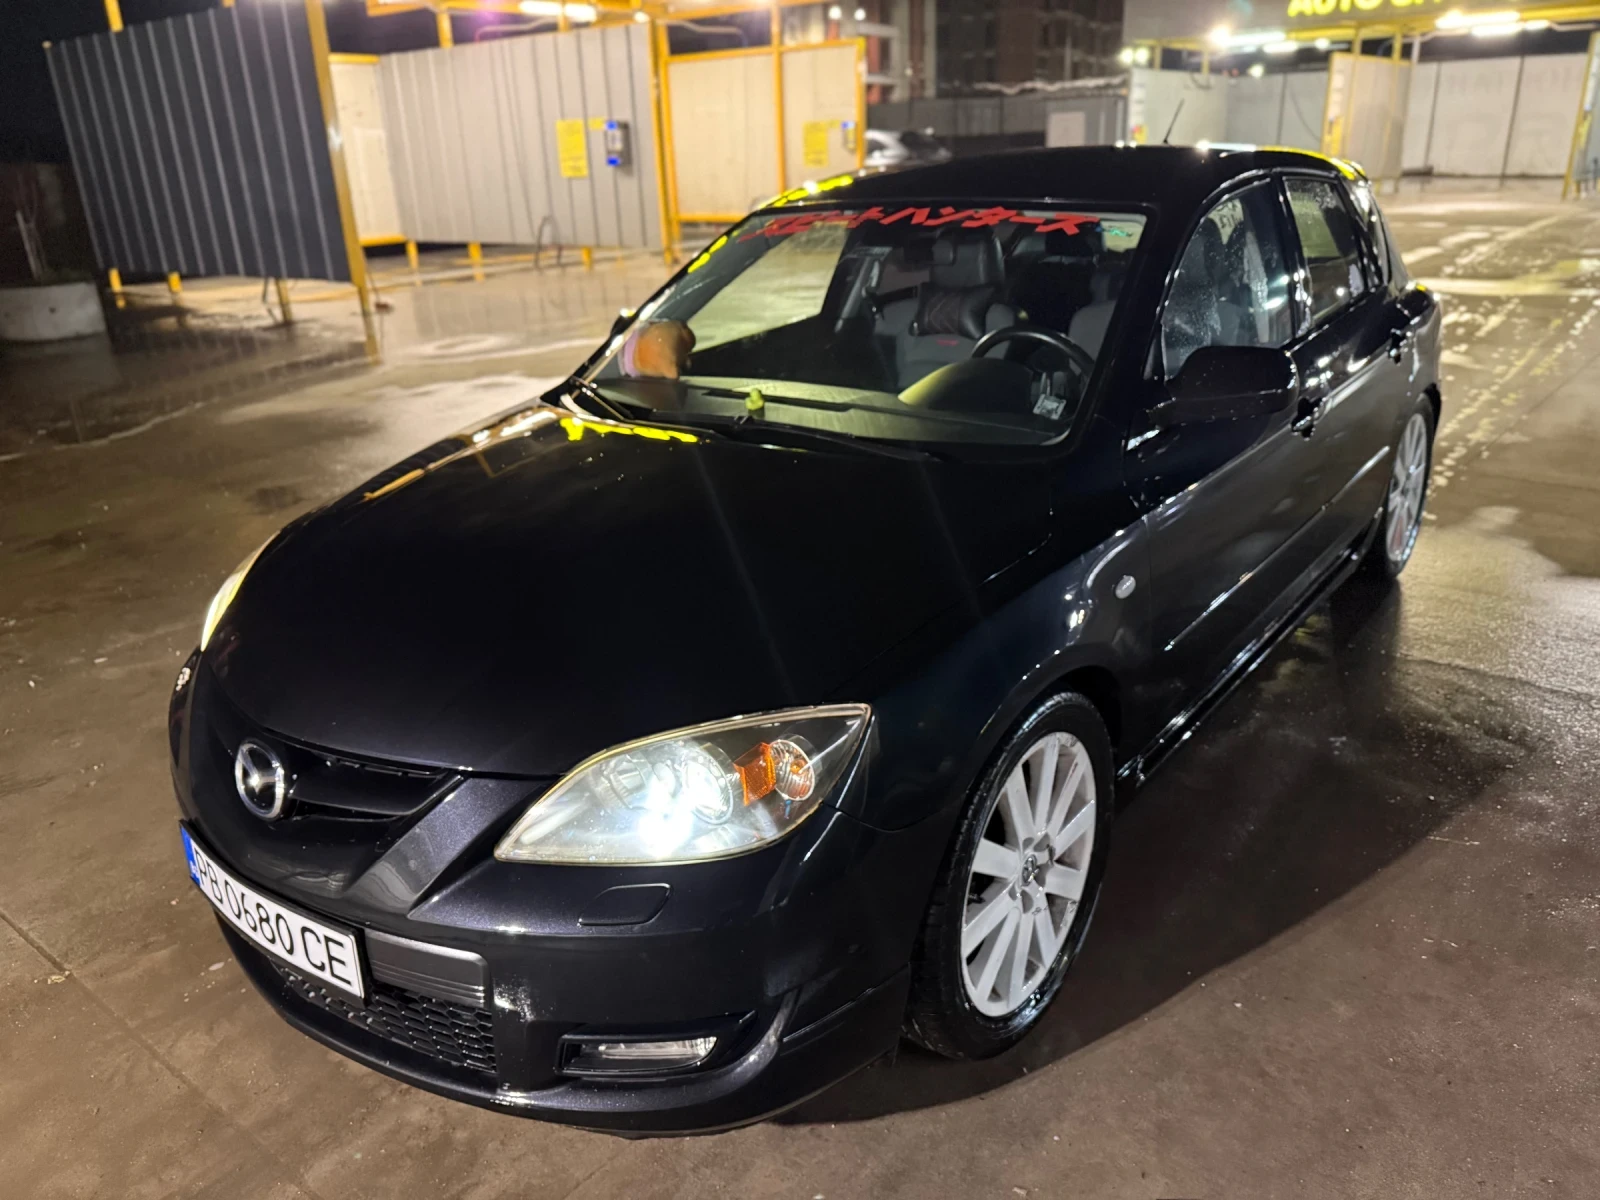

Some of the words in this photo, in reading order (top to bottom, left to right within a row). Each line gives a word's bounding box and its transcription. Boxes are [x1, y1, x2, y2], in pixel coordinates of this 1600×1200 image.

[195, 849, 223, 904] PB
[224, 879, 295, 956] 0680
[300, 925, 352, 986] CE
